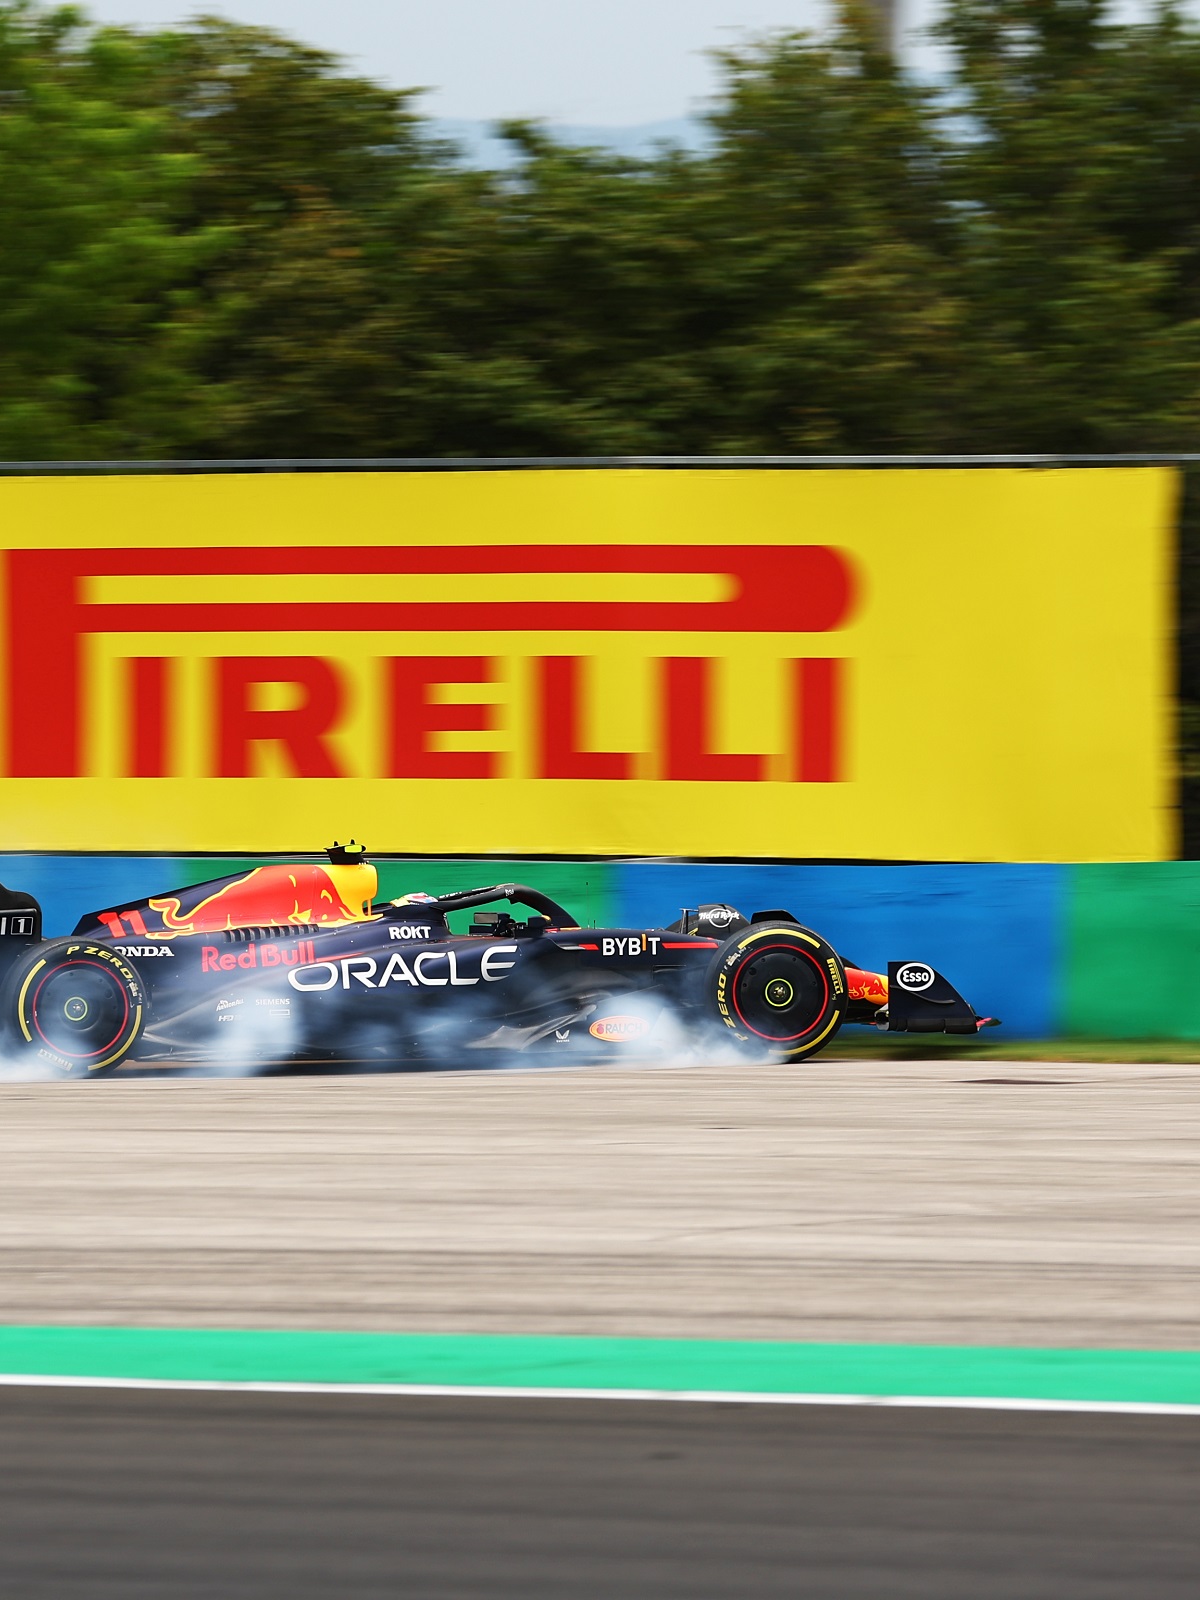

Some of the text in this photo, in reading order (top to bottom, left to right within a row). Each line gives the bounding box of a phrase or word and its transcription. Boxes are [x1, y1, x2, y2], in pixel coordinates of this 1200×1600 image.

[97, 910, 148, 938] 11
[388, 925, 431, 939] ROKT
[201, 941, 316, 972] Red Bull
[602, 933, 661, 956] BYBIT
[66, 945, 134, 980] P ZERO
[287, 945, 518, 992] ORACLE
[826, 957, 844, 994] PIRELLI
[255, 998, 290, 1006] SIEMENS
[717, 972, 737, 1029] ZERO
[605, 1022, 643, 1034] RAUCH
